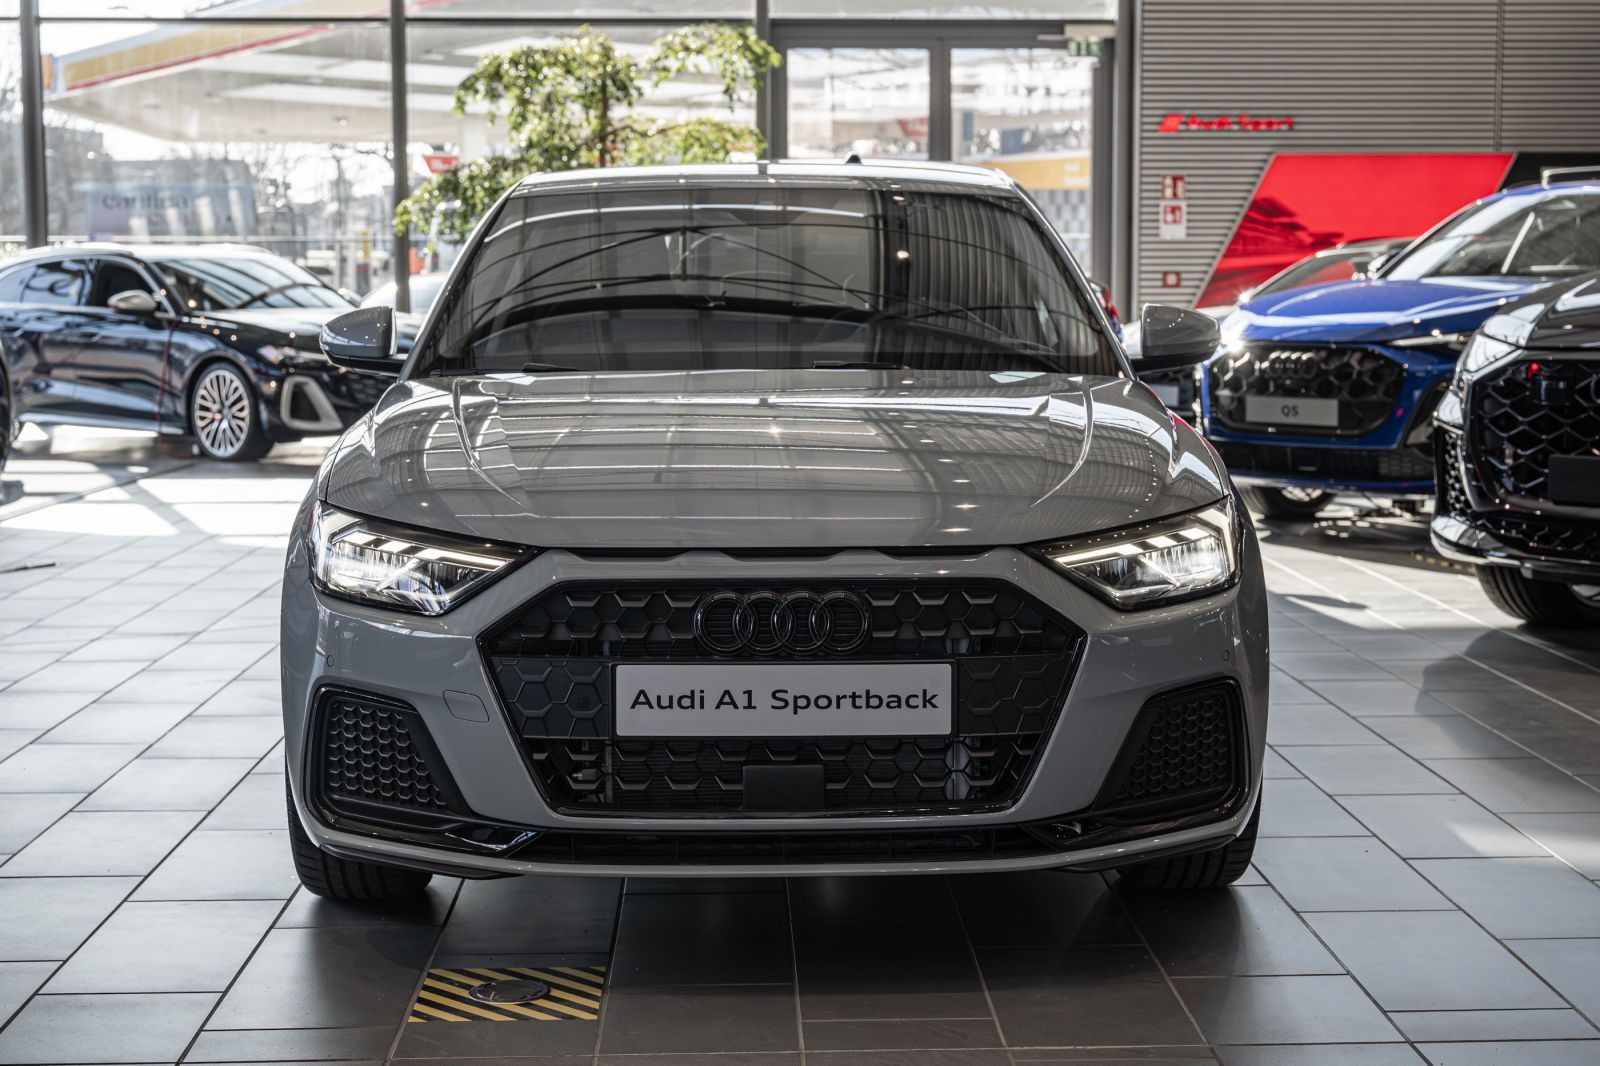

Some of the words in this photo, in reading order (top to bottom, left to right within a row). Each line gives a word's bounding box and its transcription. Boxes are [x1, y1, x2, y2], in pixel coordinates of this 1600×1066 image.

[1187, 114, 1233, 131] Audi
[1237, 114, 1293, 132] Sport
[1281, 404, 1299, 418] Q5
[630, 689, 705, 710] Audi
[714, 689, 757, 710] A1
[770, 689, 939, 715] Sportback
